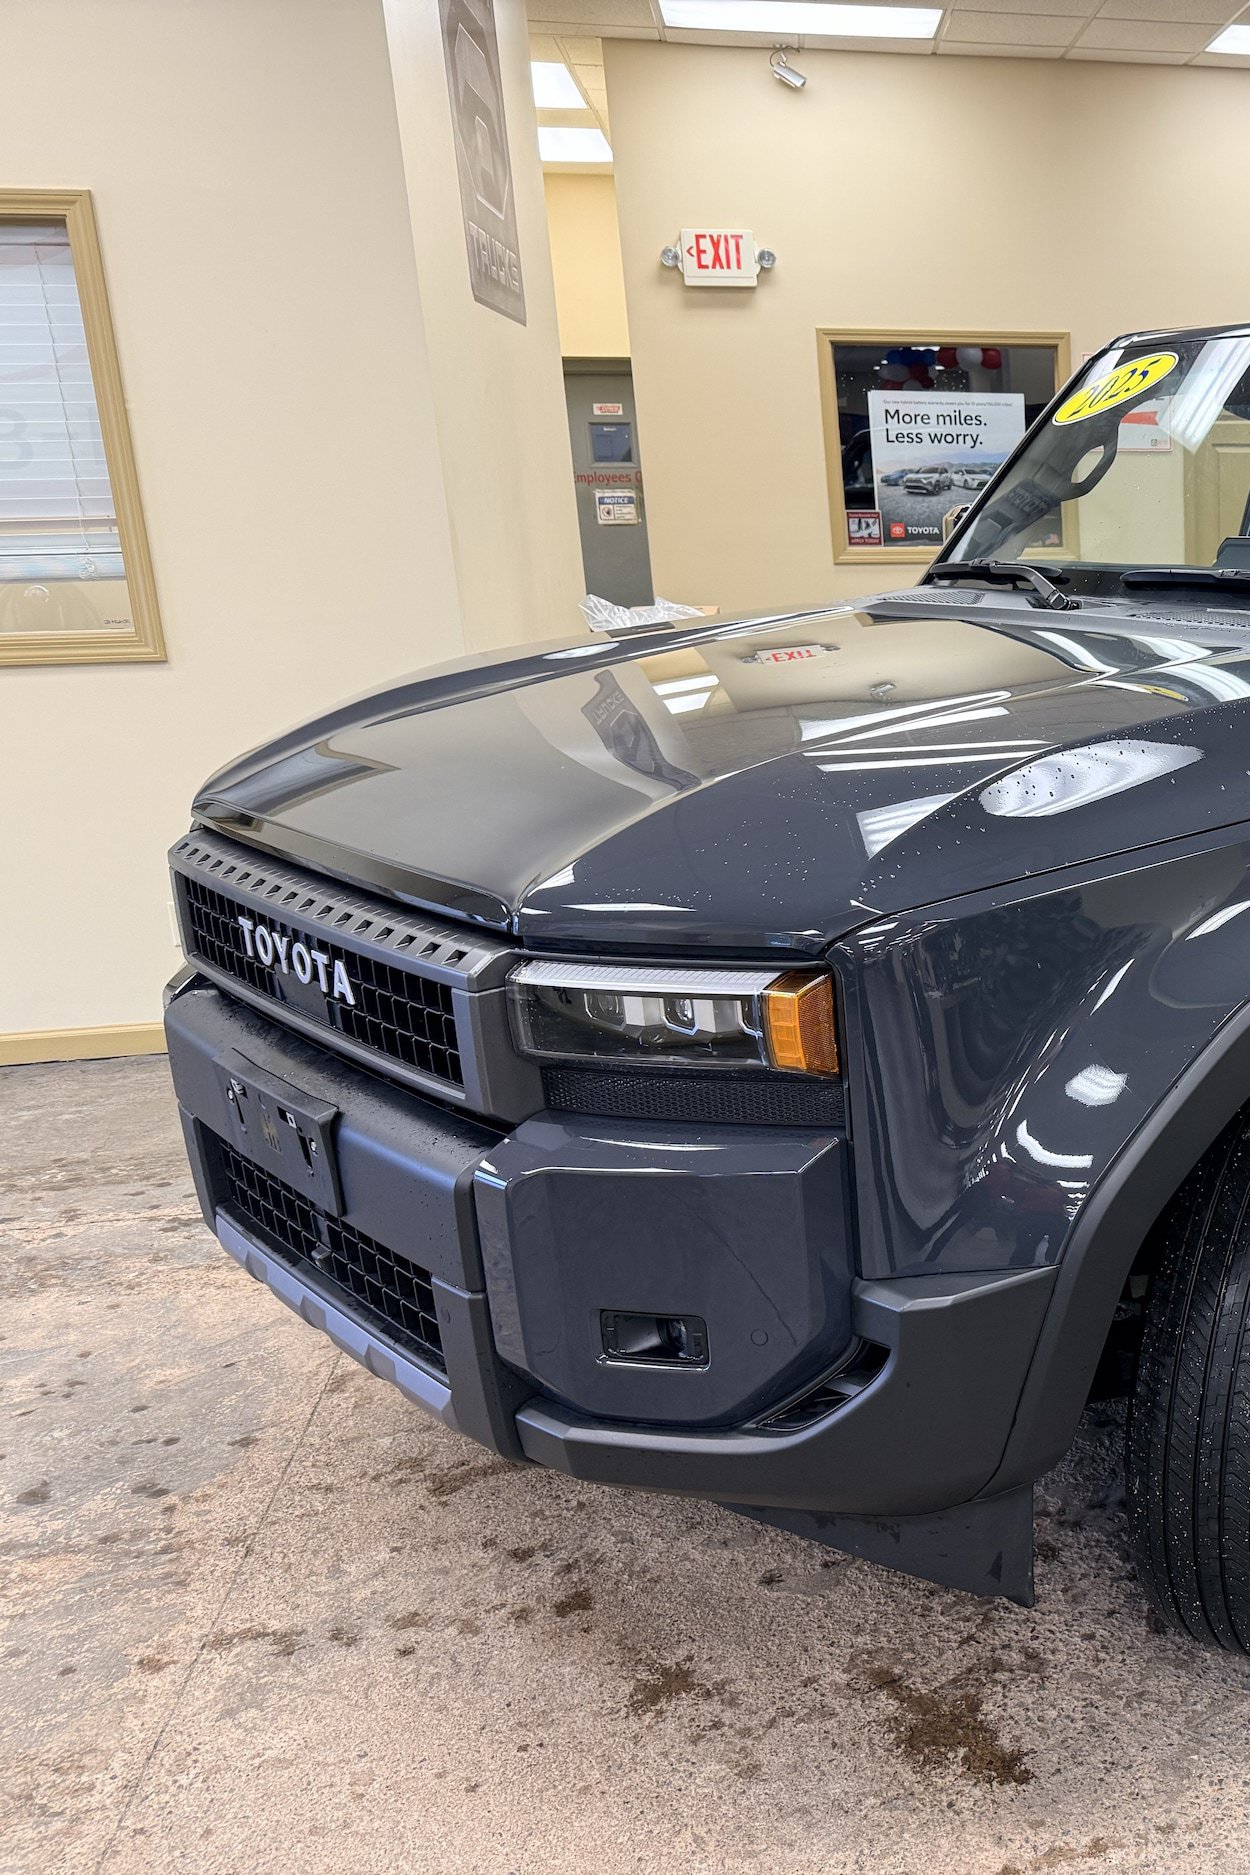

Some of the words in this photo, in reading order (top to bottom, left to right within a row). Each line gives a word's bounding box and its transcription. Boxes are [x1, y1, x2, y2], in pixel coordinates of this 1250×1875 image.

[694, 234, 743, 270] EXIT
[1066, 358, 1162, 419] 2025
[885, 409, 931, 425] More
[936, 410, 987, 426] miles.
[886, 428, 923, 444] Less
[928, 432, 983, 449] worry.
[574, 471, 631, 485] mployees
[907, 526, 940, 534] TOYOTA
[237, 916, 356, 1006] TOYOTA
